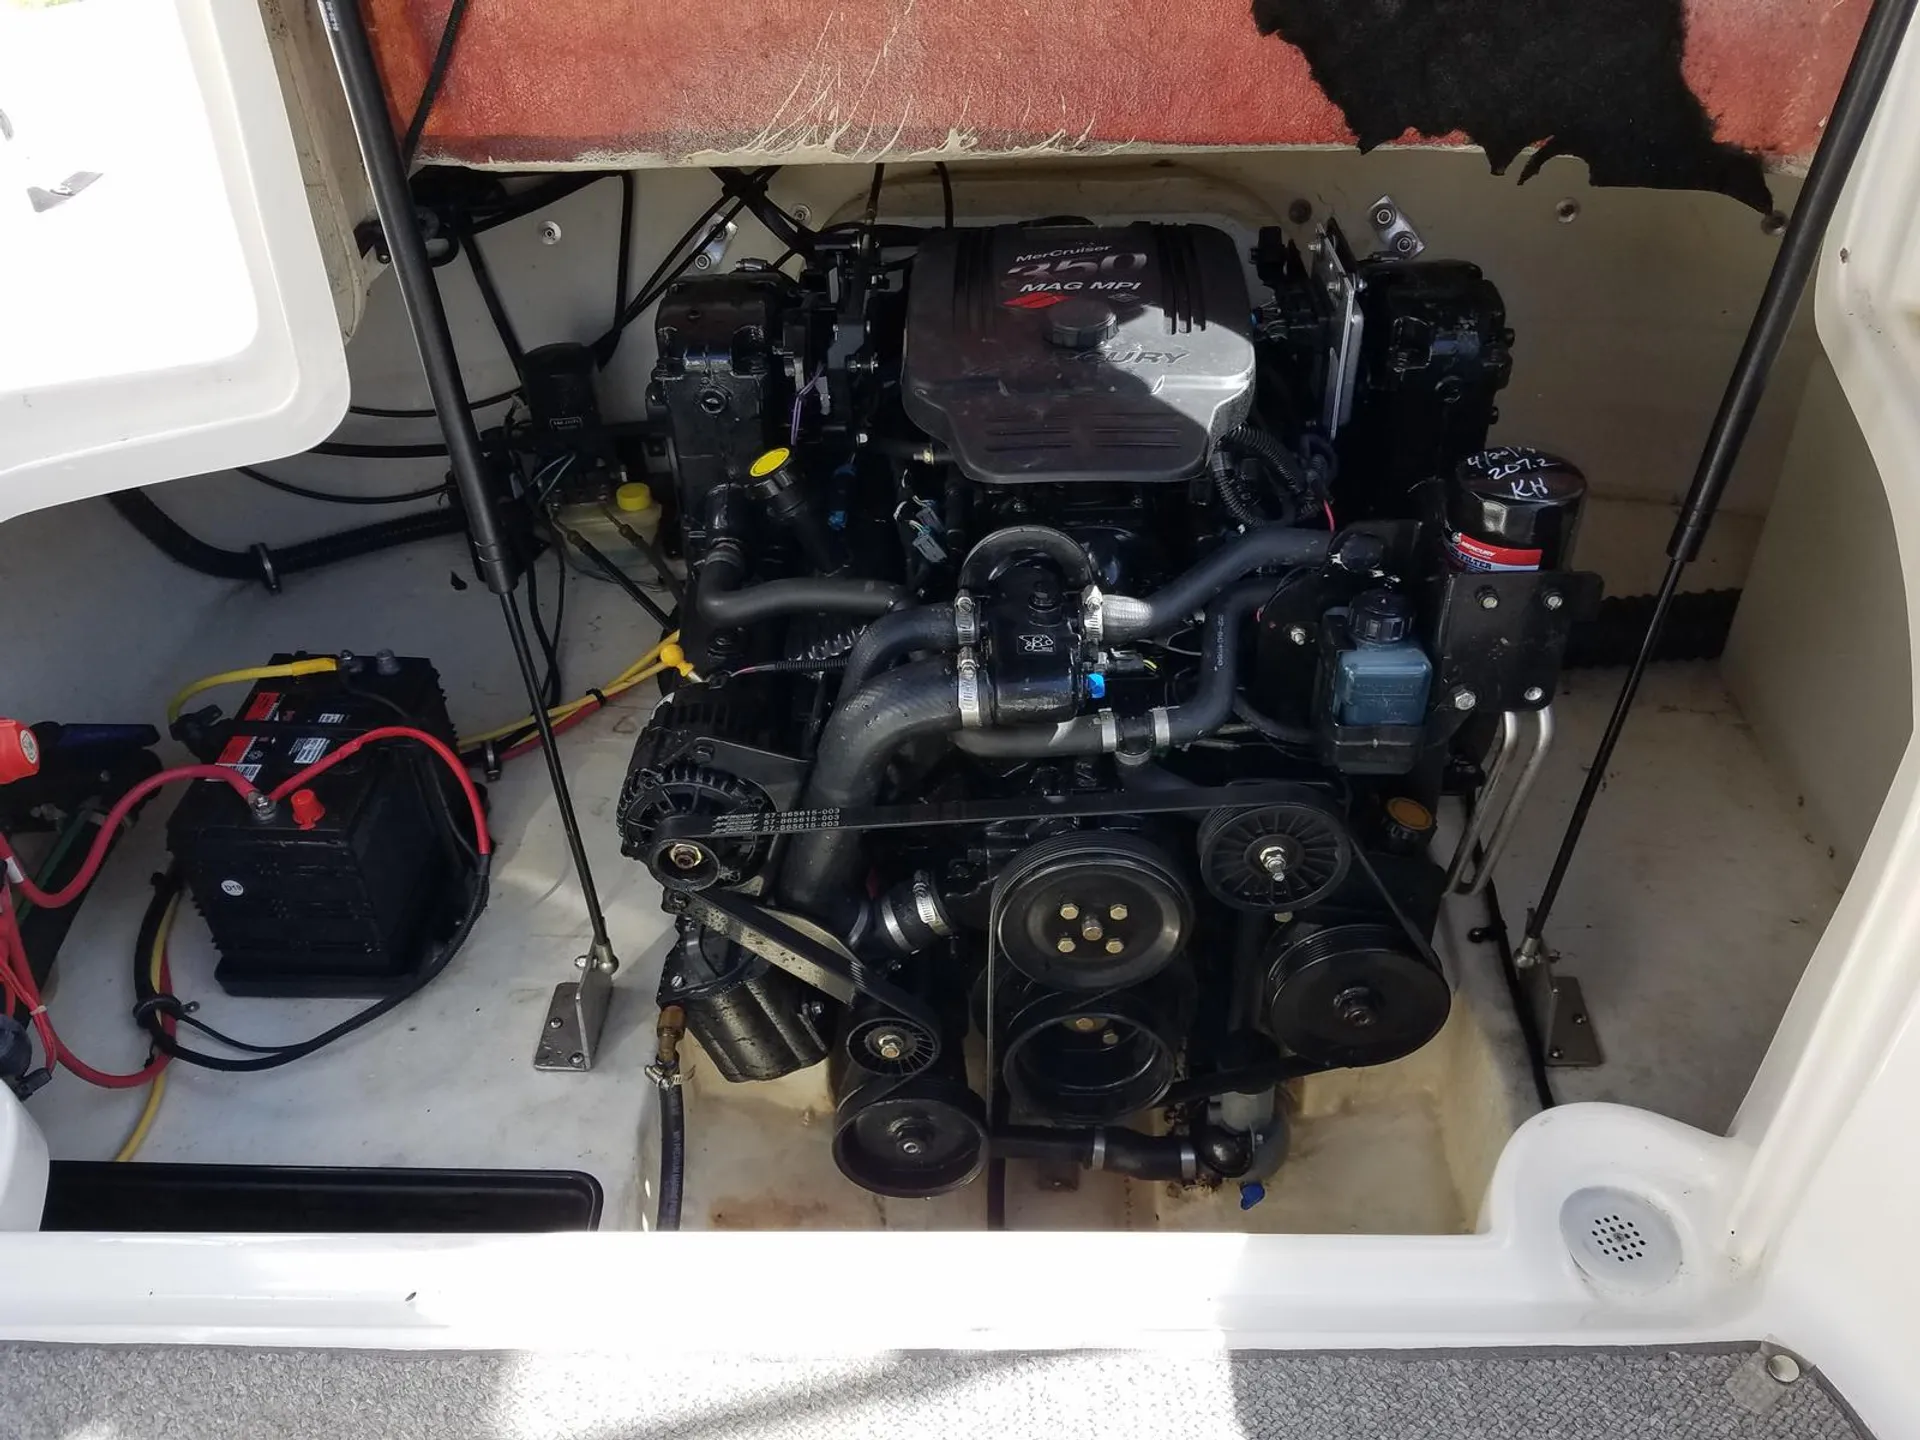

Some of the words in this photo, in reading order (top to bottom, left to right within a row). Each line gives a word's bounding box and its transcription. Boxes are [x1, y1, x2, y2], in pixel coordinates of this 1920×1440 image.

[1015, 245, 1112, 263] MerCruiser
[1004, 253, 1148, 284] 350
[1020, 281, 1084, 292] MAG
[1089, 281, 1143, 291] MPI
[1511, 477, 1549, 500] KH
